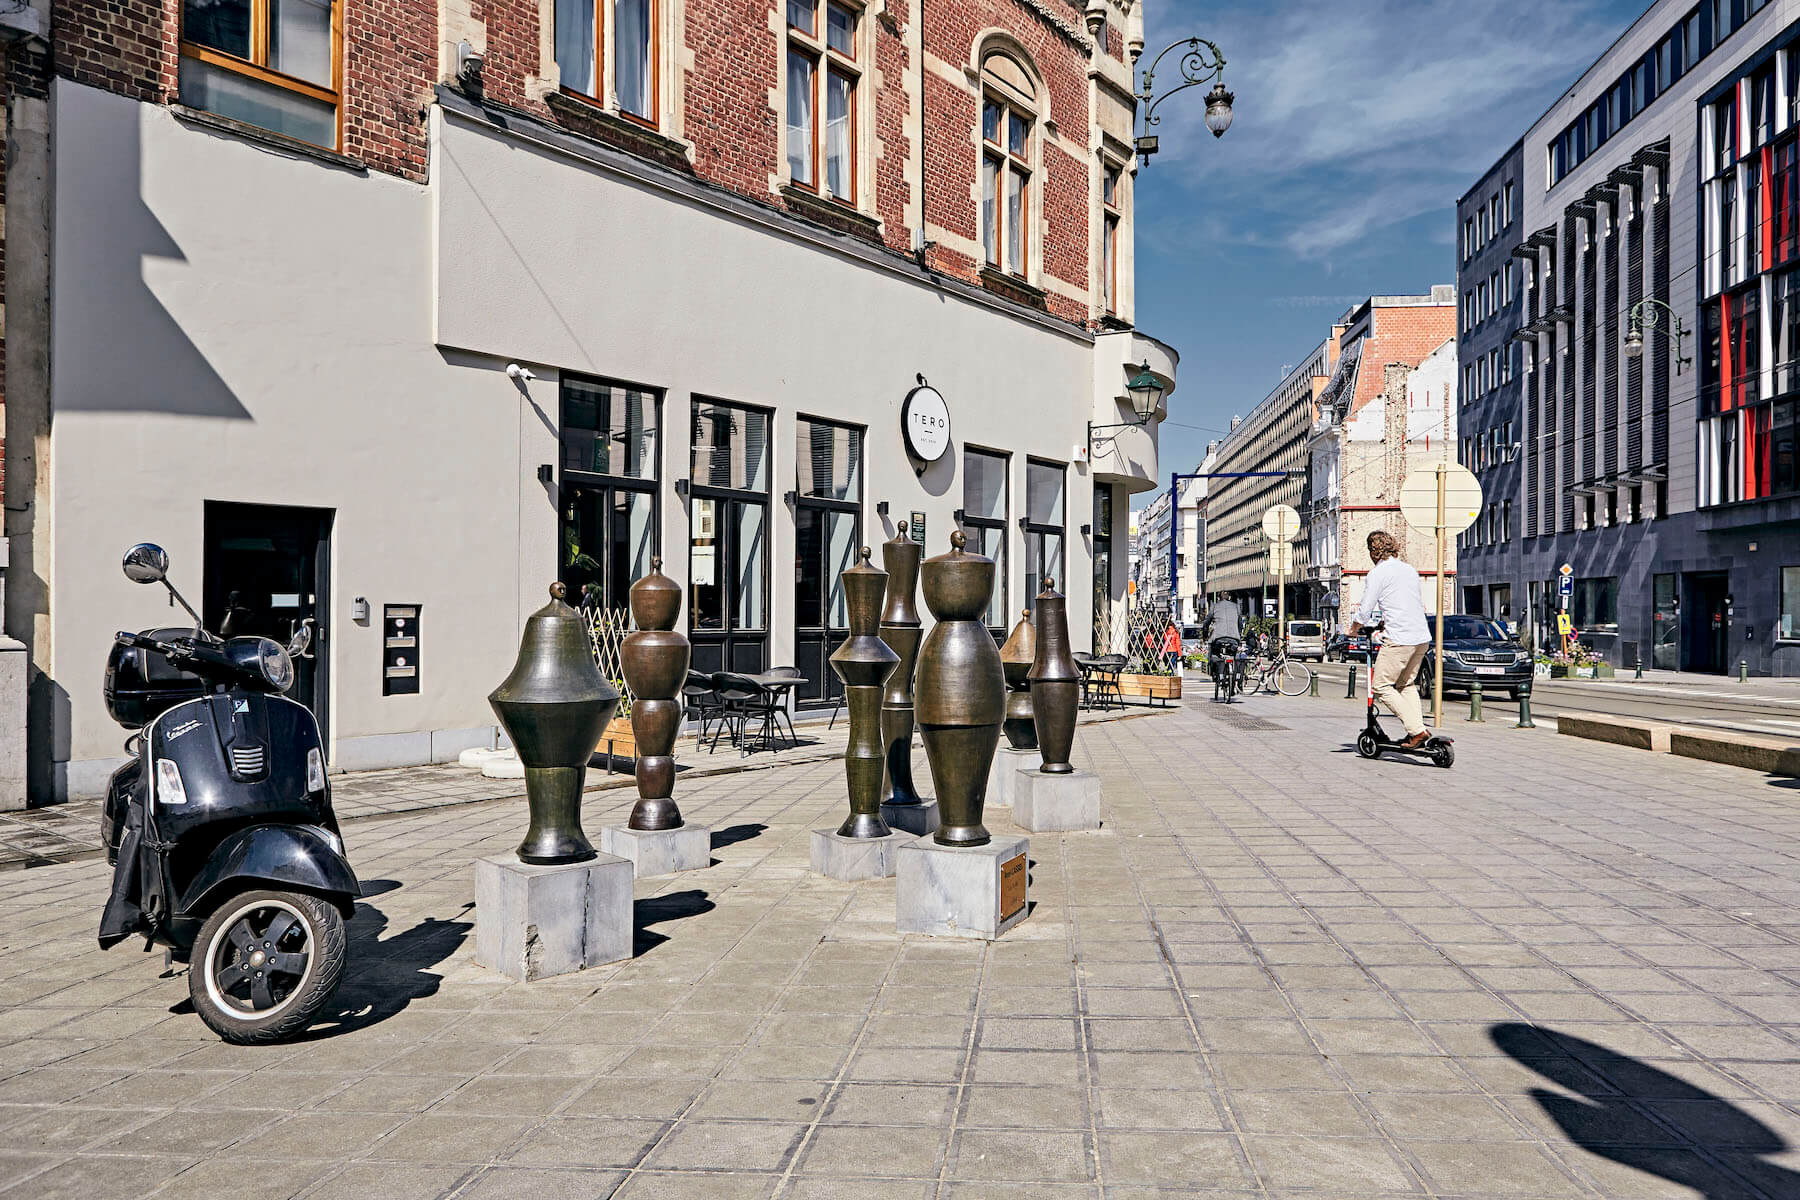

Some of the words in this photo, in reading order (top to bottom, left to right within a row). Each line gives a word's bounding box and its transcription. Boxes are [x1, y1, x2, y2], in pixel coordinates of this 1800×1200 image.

[913, 413, 945, 428] TERO
[1561, 577, 1570, 588] P
[1265, 605, 1273, 614] P
